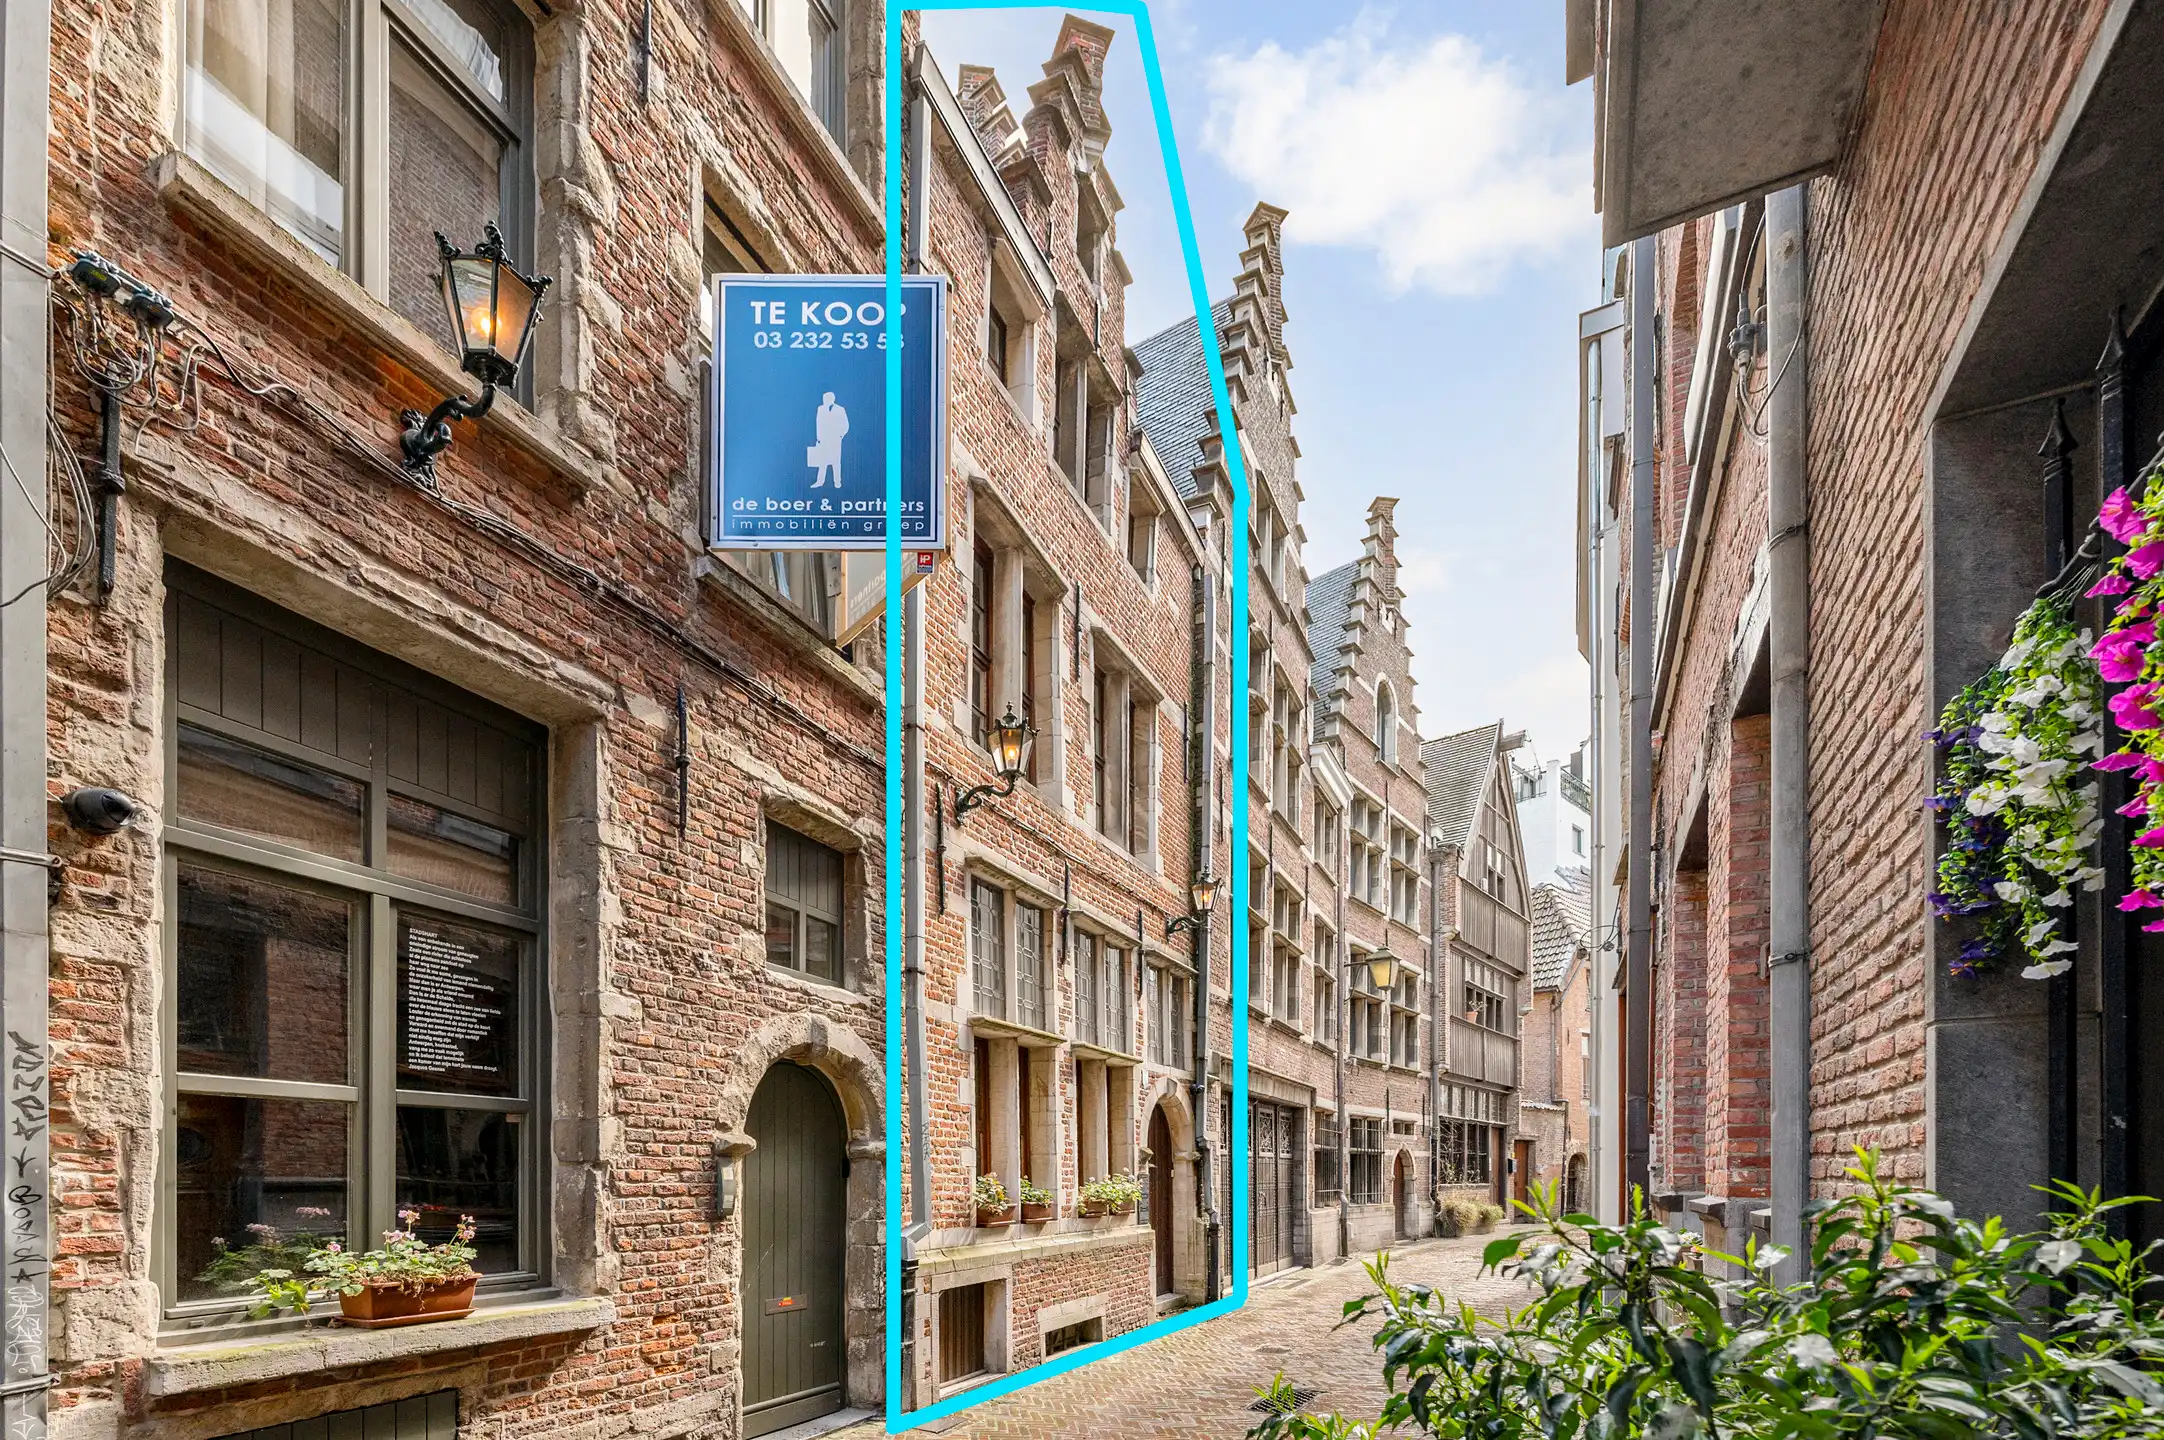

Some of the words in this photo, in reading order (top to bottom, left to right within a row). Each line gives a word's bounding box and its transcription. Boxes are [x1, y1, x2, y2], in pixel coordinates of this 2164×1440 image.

[750, 301, 786, 325] TE
[801, 301, 907, 327] KOO
[754, 331, 783, 349] 03
[789, 331, 833, 349] 232
[840, 332, 869, 350] 53
[876, 332, 905, 350] 5
[732, 497, 758, 511] de
[766, 497, 813, 512] boer
[820, 498, 833, 511] &
[732, 519, 850, 530] immobiliën
[863, 521, 925, 532] grep
